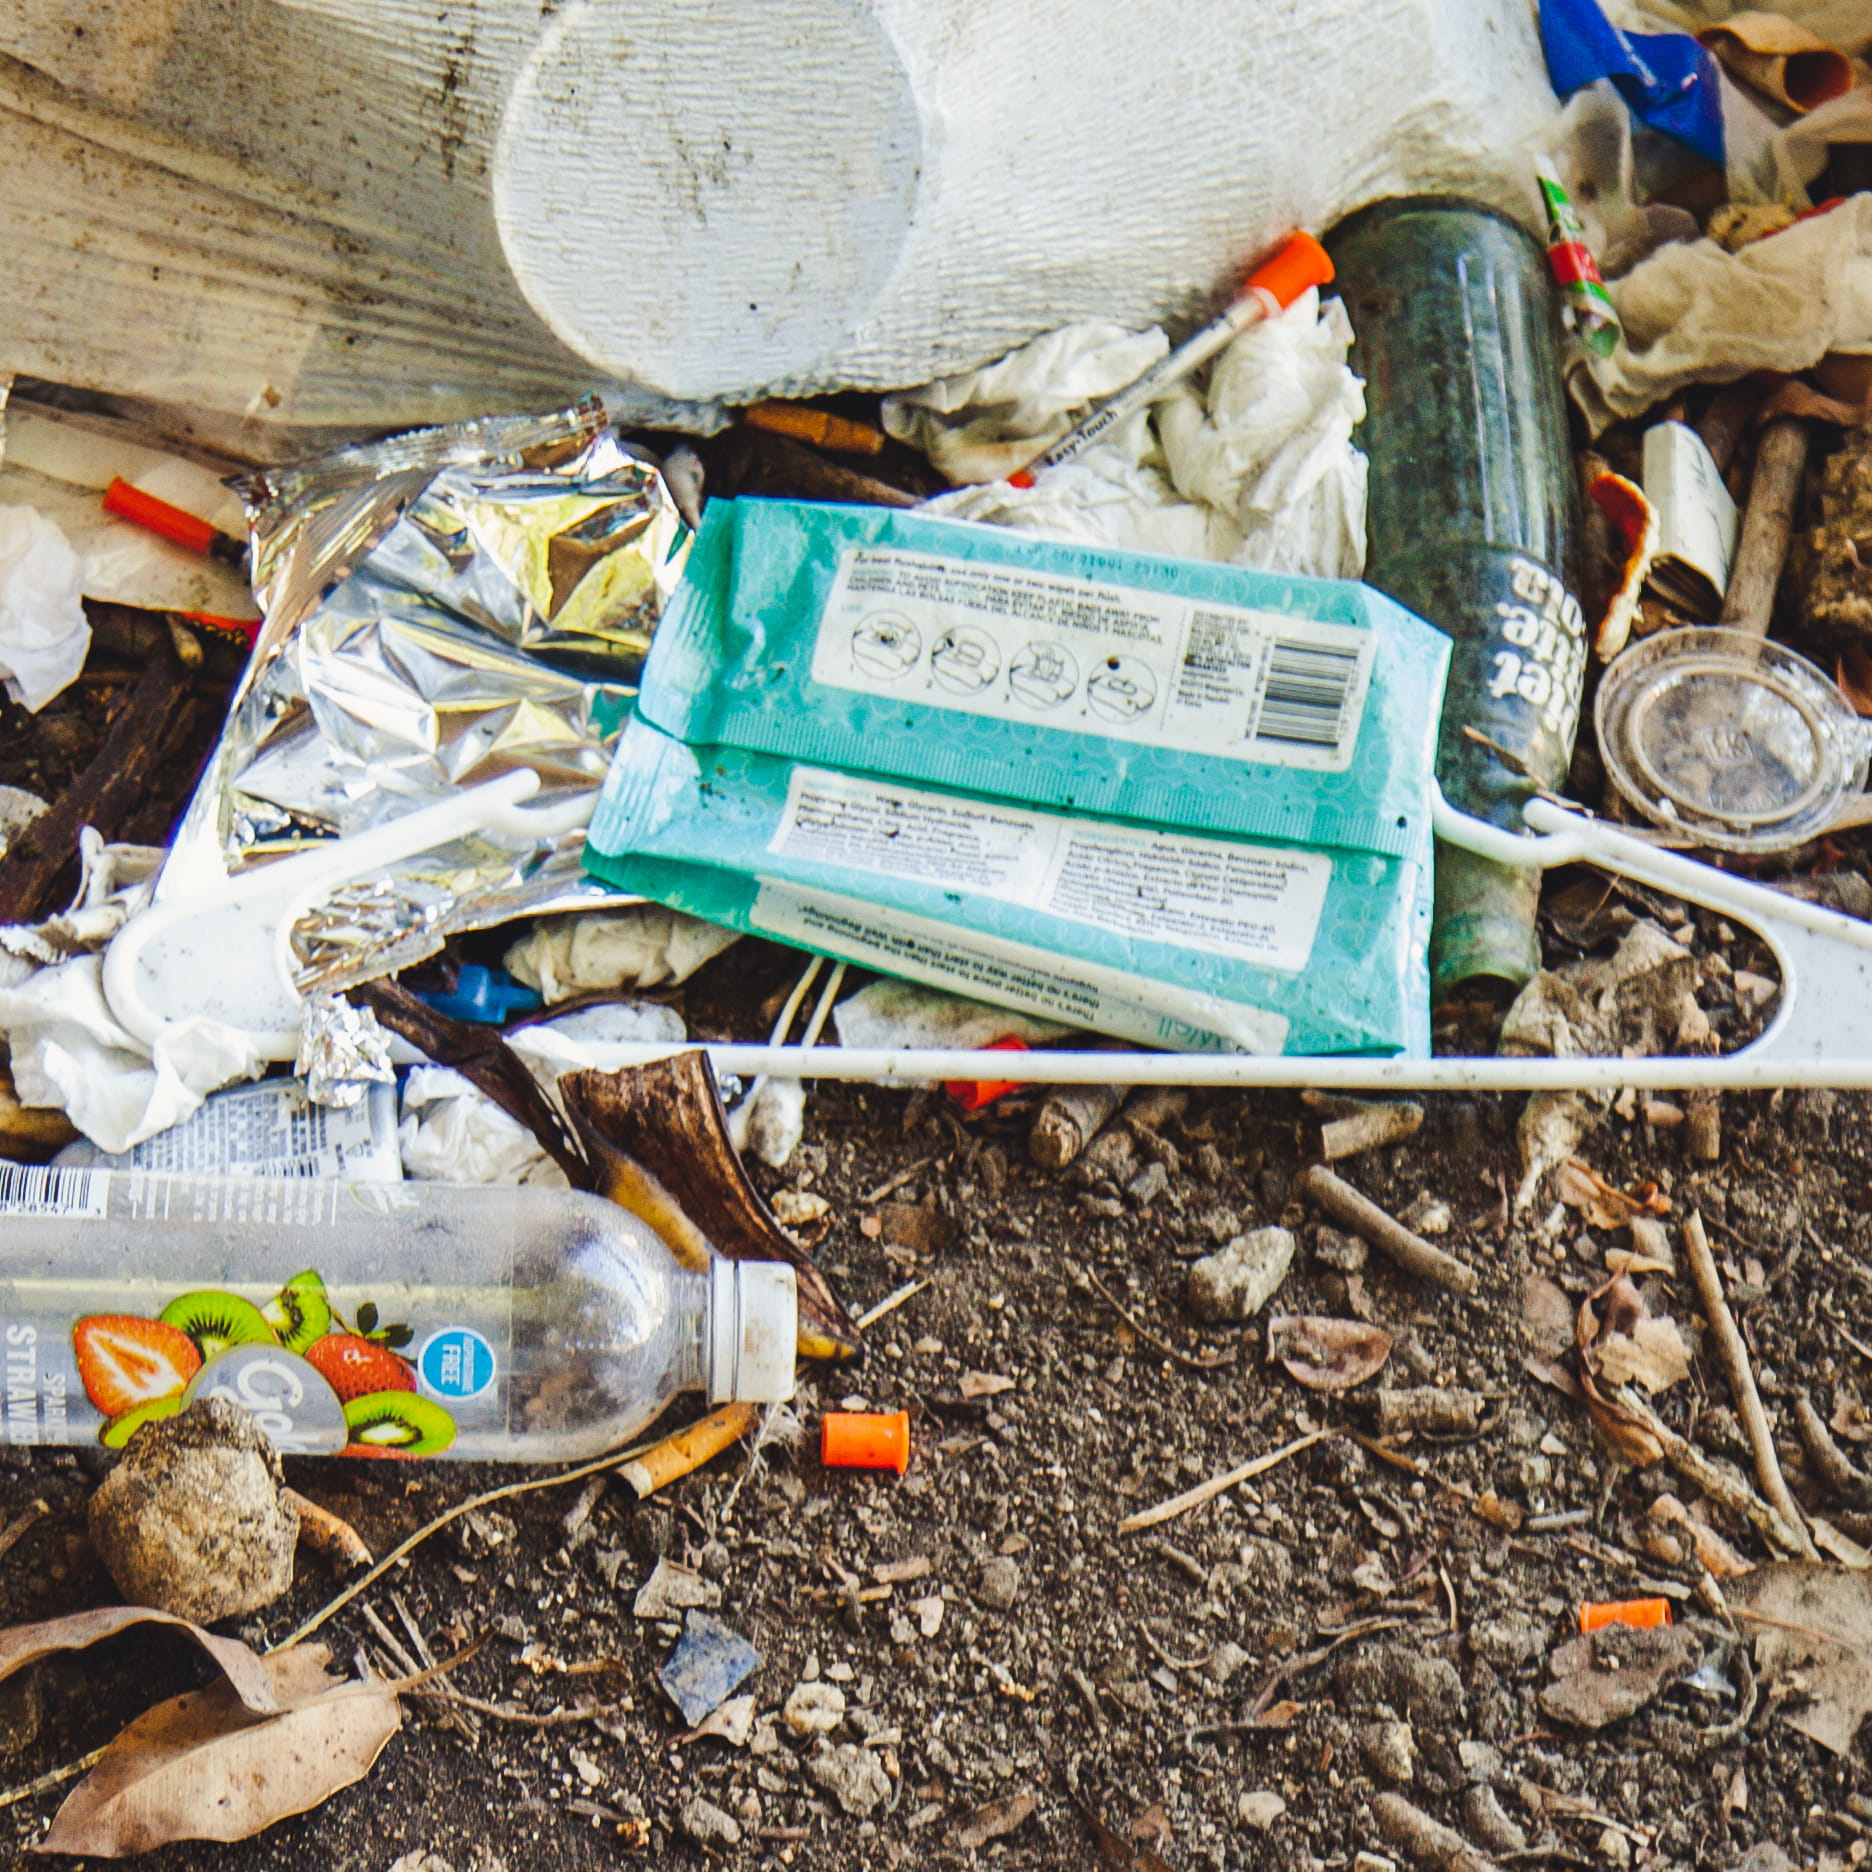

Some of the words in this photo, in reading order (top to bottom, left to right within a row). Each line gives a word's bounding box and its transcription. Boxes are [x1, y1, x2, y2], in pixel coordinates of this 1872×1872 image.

[890, 934, 916, 951] ith
[19, 1203, 68, 1215] 28547
[440, 1345, 459, 1385] FREE
